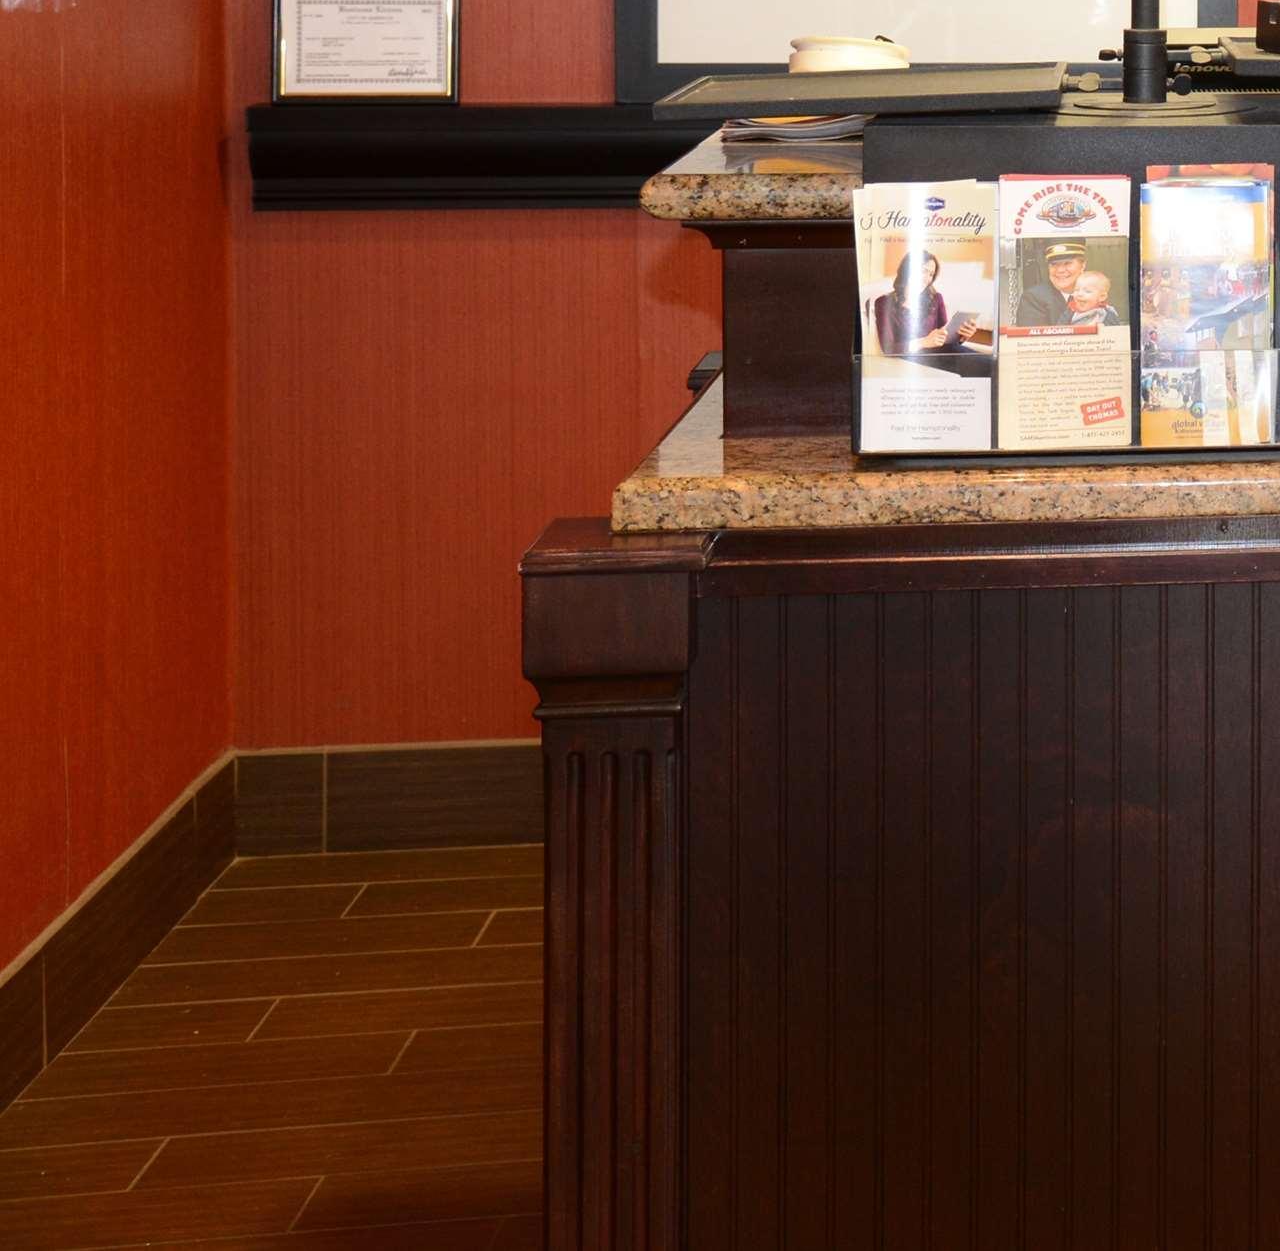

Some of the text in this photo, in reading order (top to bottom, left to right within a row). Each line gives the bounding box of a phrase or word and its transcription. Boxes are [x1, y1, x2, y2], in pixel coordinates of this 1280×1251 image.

[1014, 183, 1119, 234] COME RIDE THE TRAIN!
[877, 210, 987, 235] Hatonality
[1029, 326, 1041, 335] ALL
